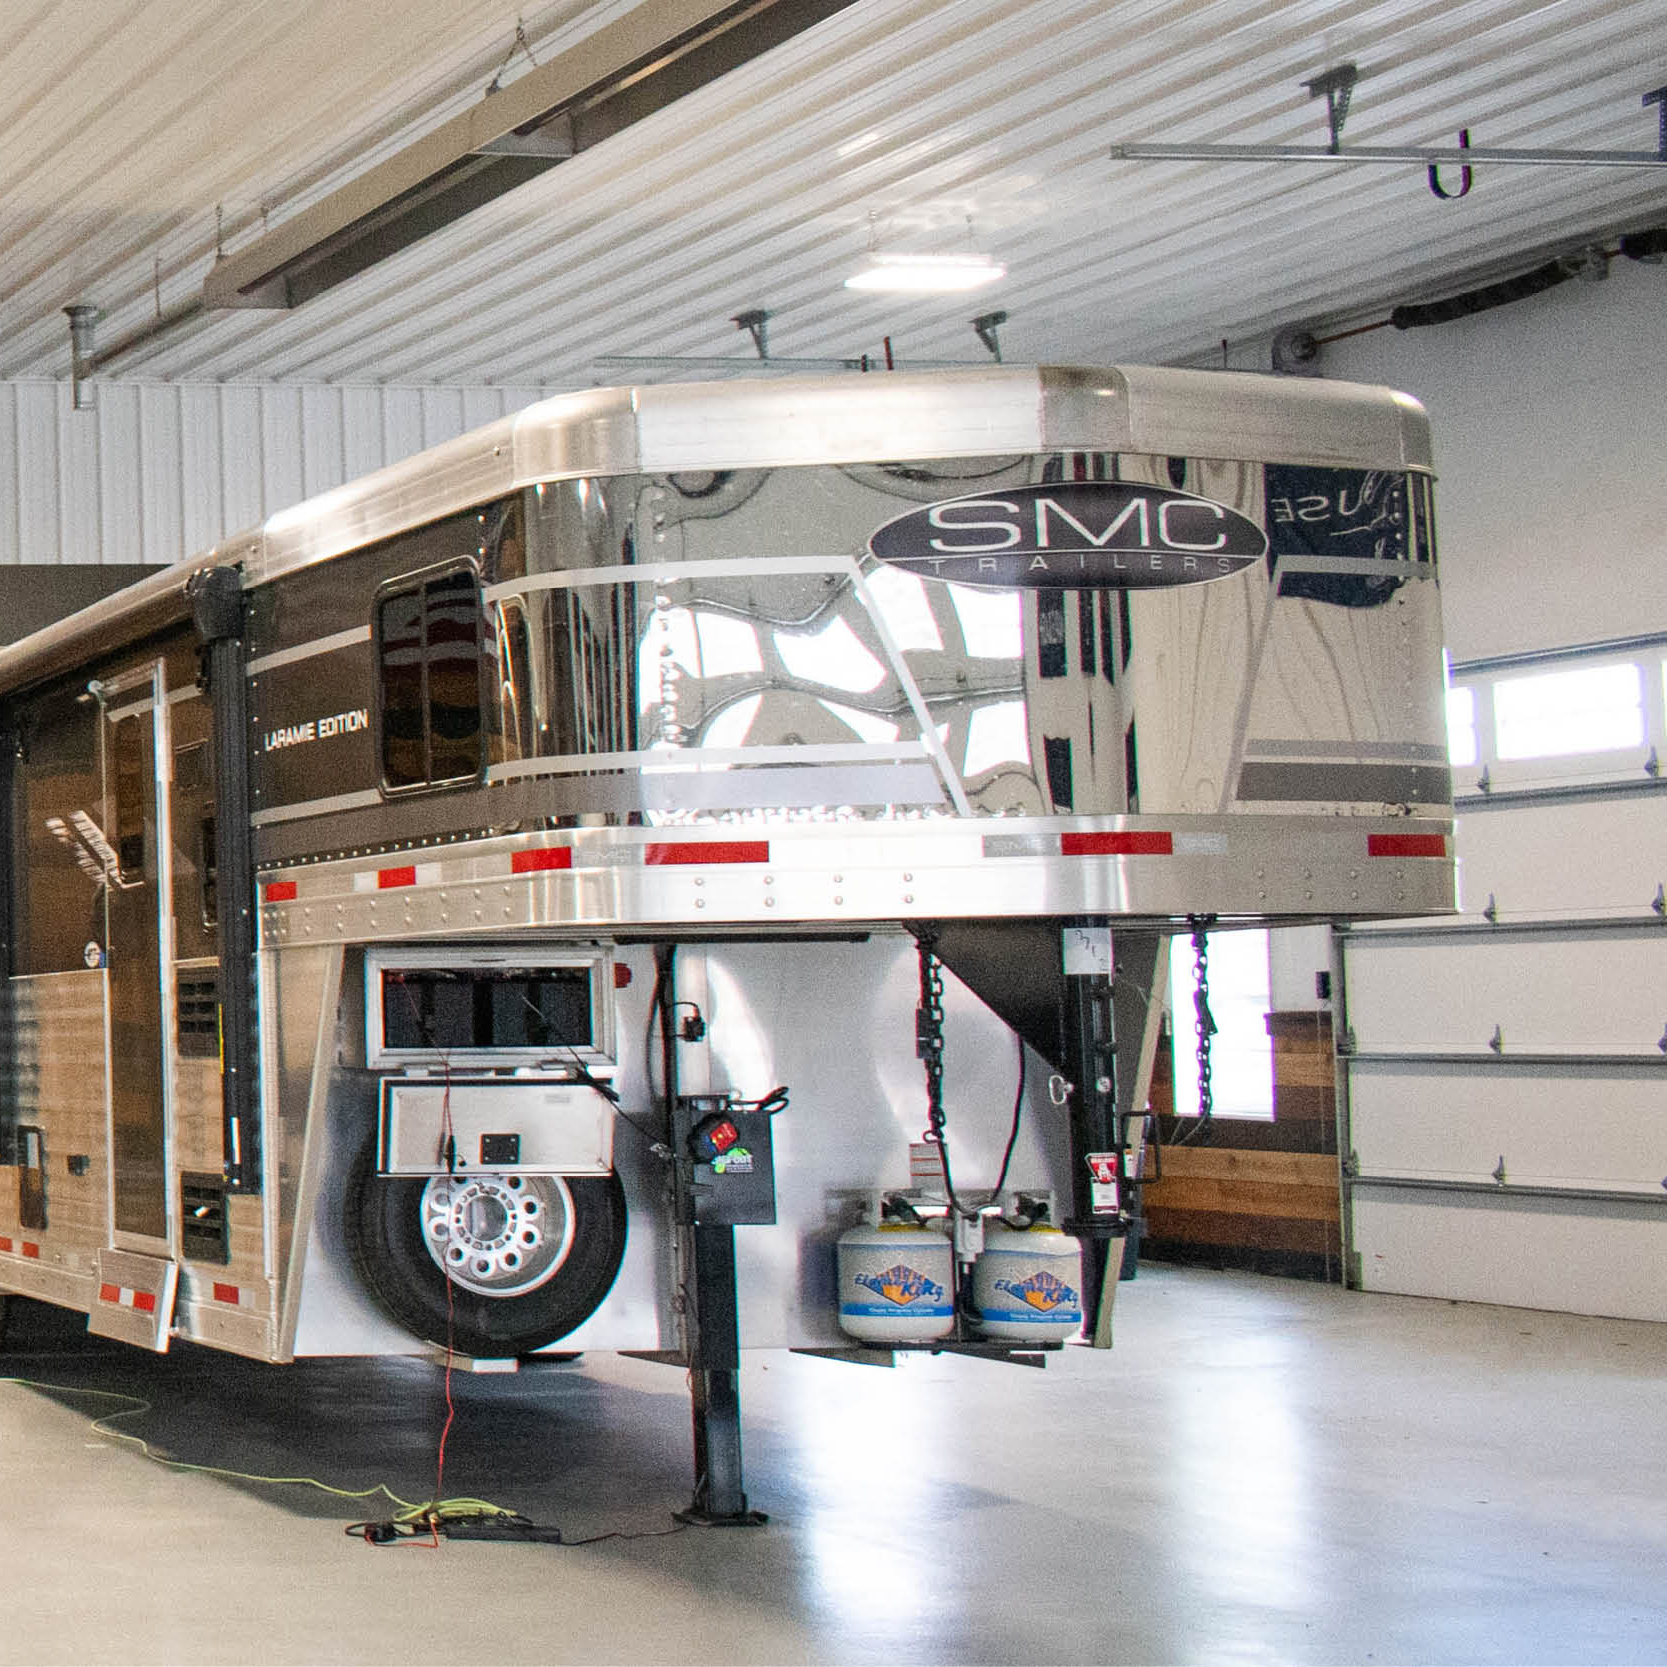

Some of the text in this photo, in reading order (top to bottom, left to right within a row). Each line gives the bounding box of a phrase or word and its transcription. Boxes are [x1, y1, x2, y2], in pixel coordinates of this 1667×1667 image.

[929, 497, 1227, 552] SMC
[928, 554, 1233, 575] TRAILERS
[264, 708, 369, 751] LARAMIE EDITION
